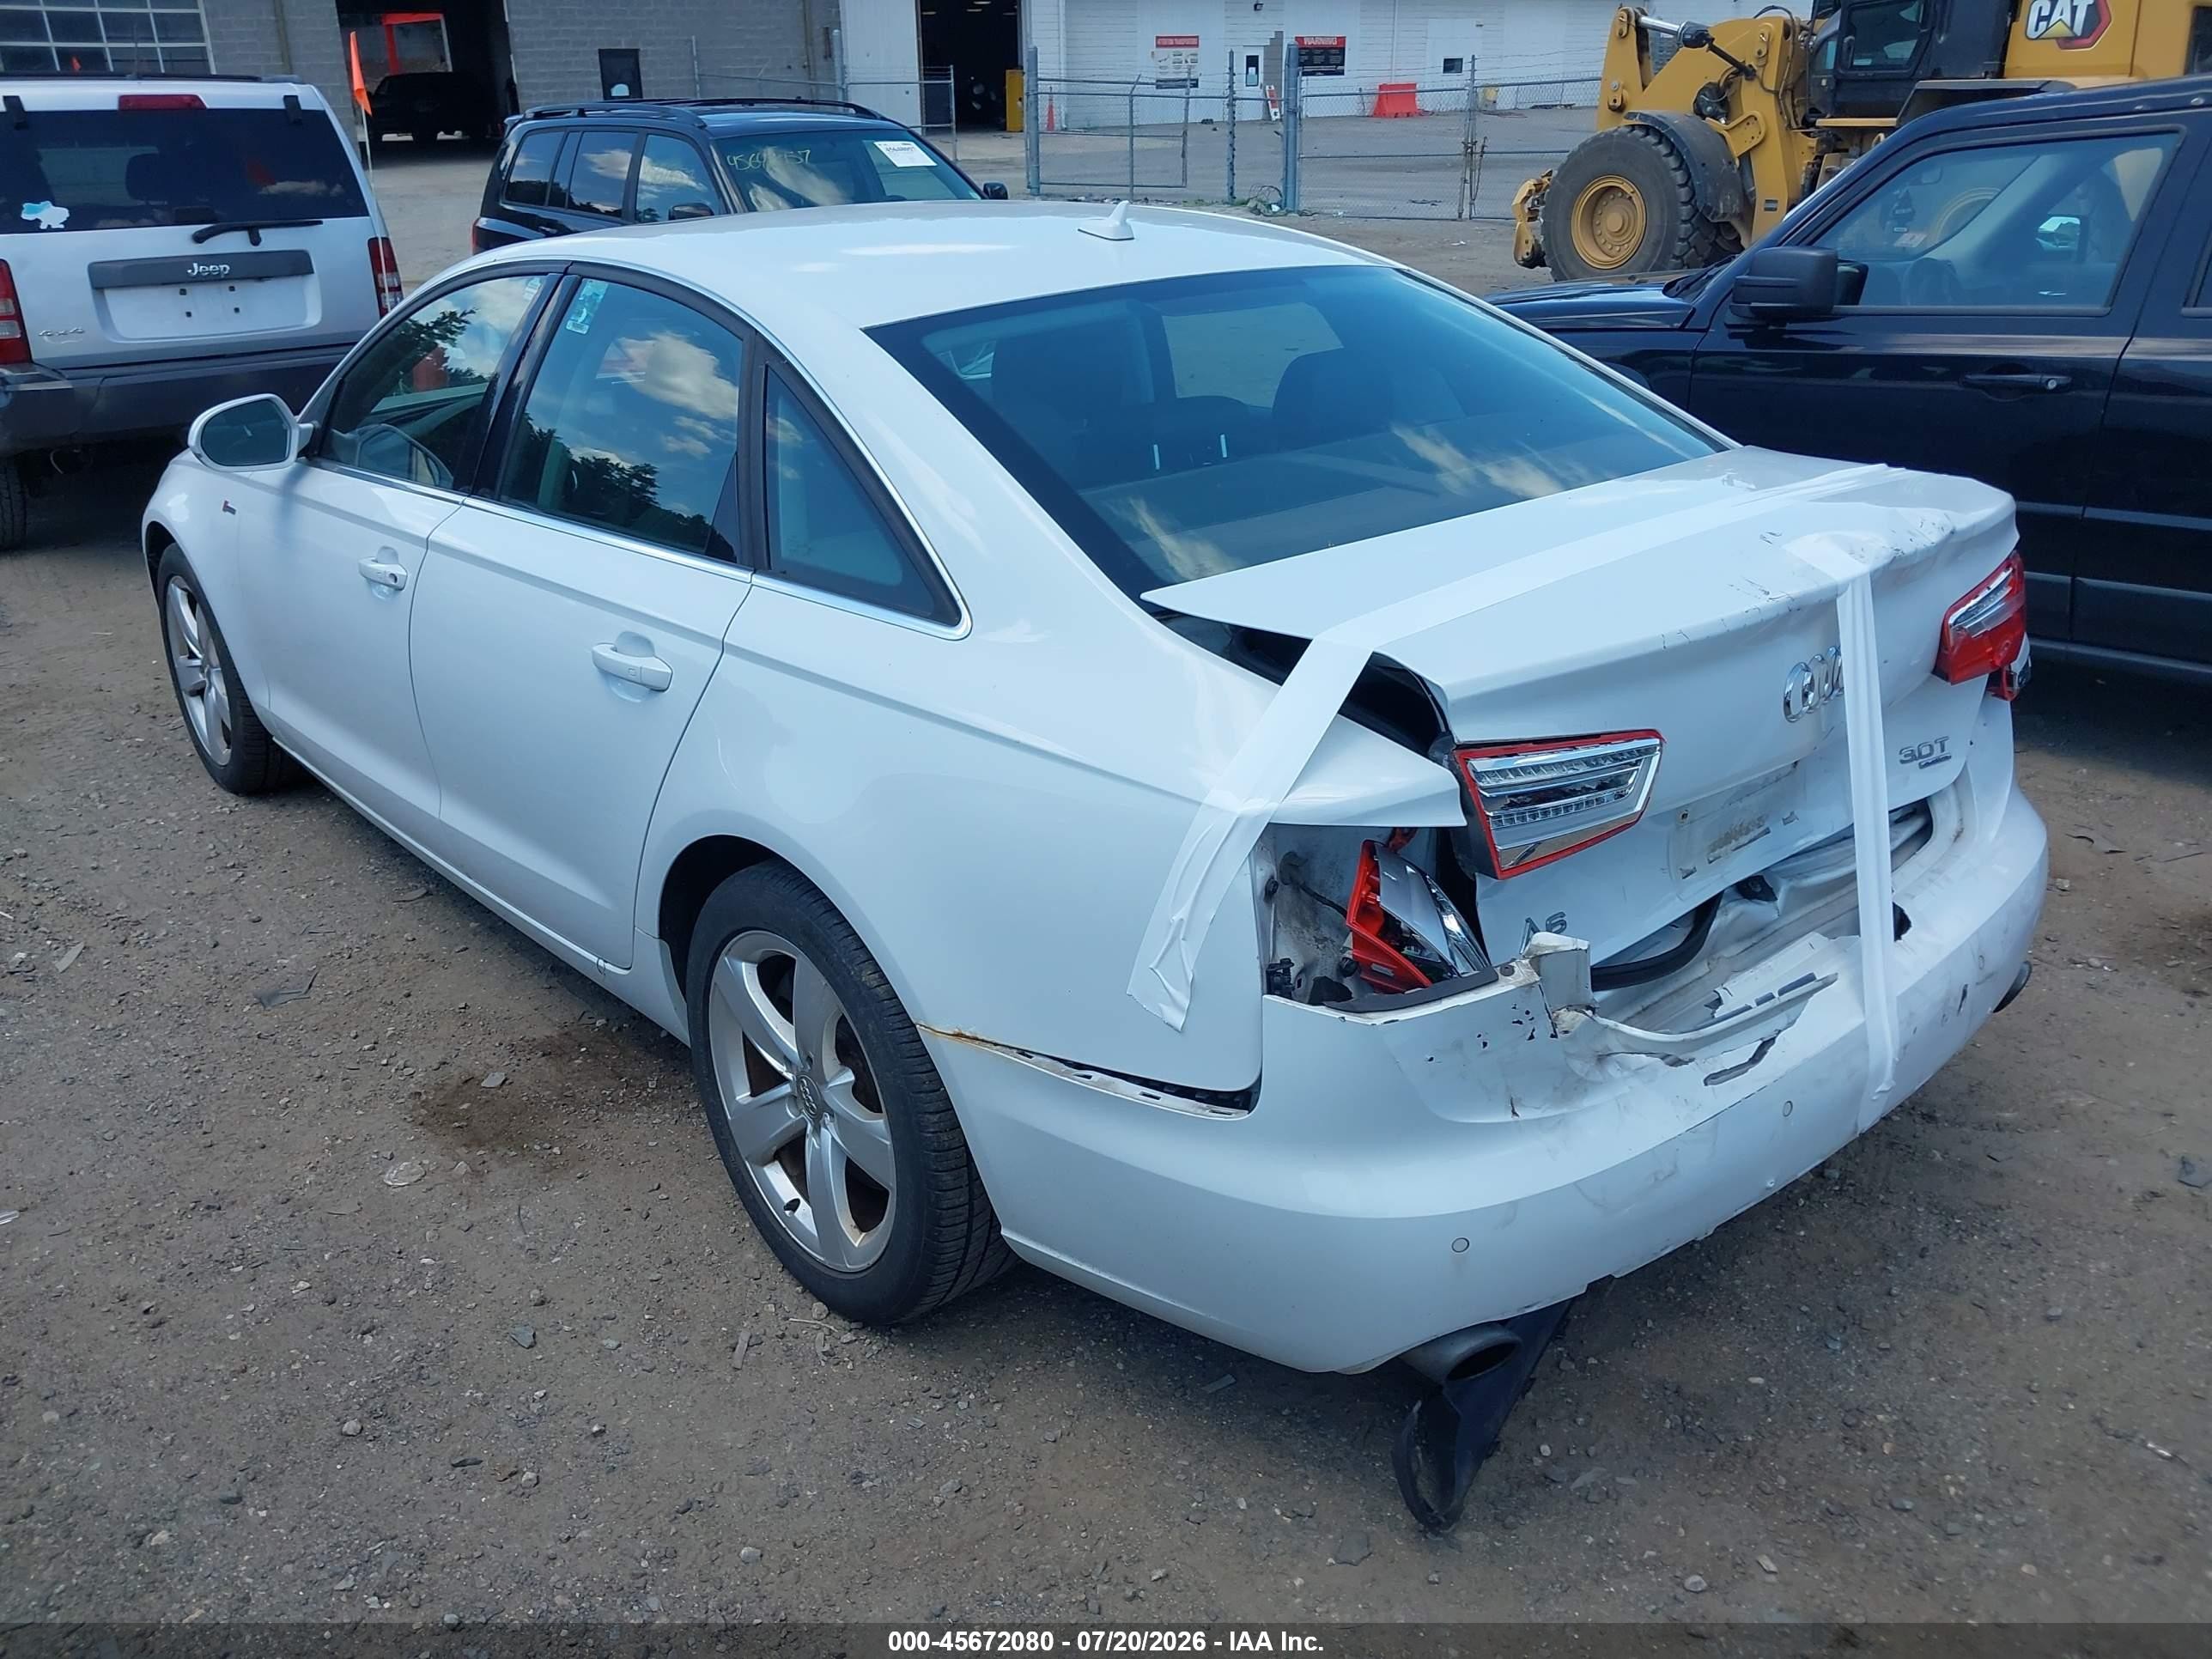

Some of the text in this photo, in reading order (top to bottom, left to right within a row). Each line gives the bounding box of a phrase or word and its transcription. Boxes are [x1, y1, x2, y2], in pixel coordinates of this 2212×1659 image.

[2027, 0, 2094, 39] CAT
[1304, 37, 1337, 46] WARNING
[186, 262, 230, 278] Jeep
[1519, 911, 1567, 954] A6
